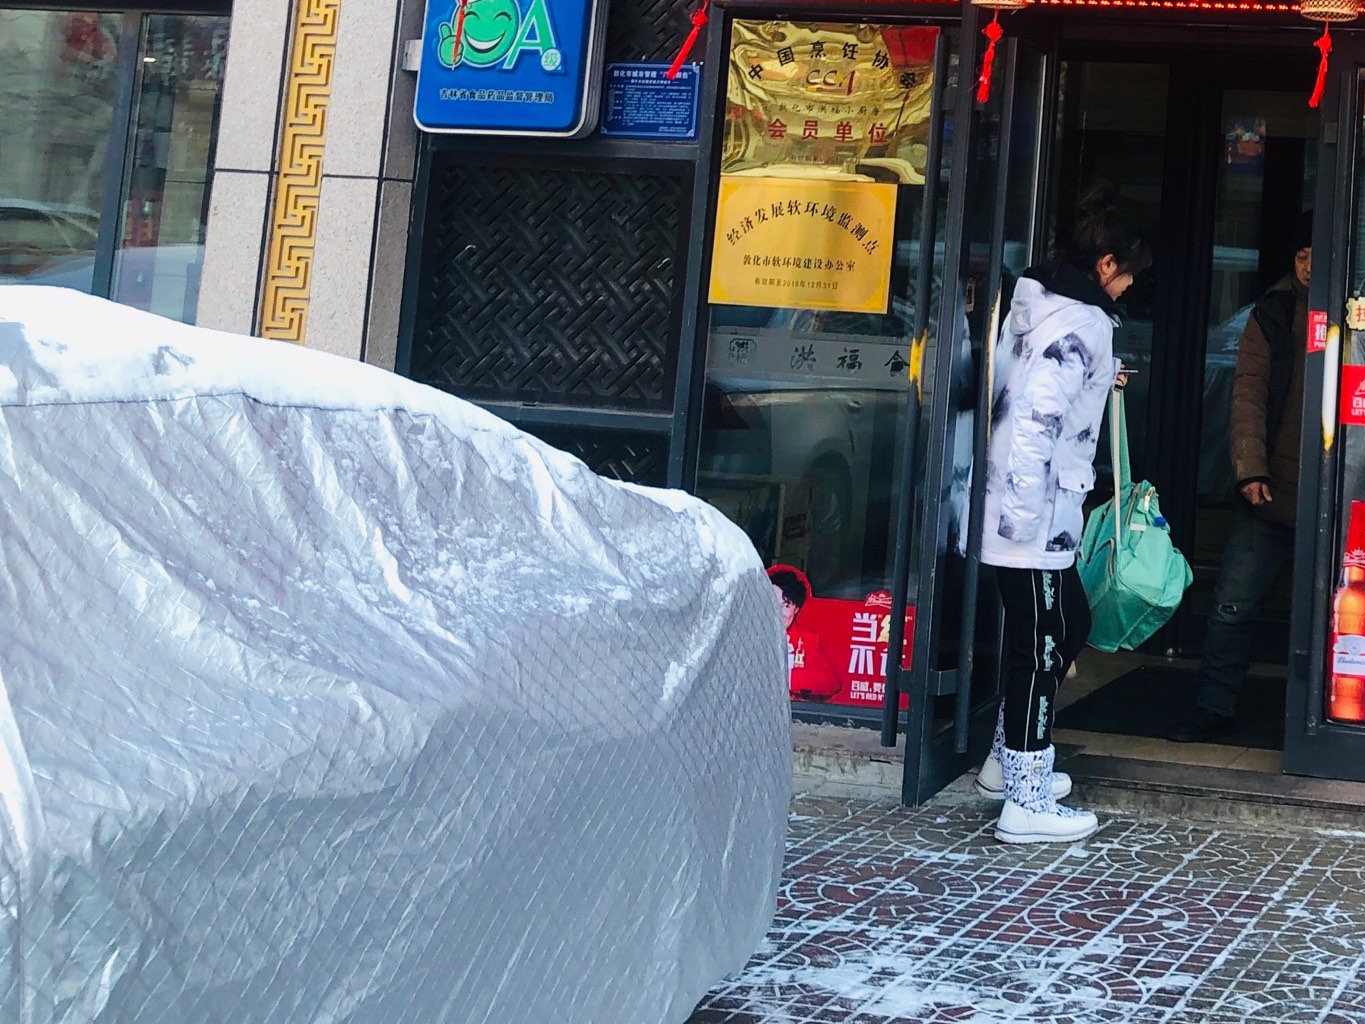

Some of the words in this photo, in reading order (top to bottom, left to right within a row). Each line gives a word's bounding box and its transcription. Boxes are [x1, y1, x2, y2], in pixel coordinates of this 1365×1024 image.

[748, 40, 919, 91] 中国烹饪协会
[439, 87, 555, 105] 吉林省食品药品监督管理局
[767, 118, 890, 144] 会员单位
[726, 199, 880, 255] 经济发展软环境监测点
[743, 254, 856, 272] 敦化市软环境建设办公室
[850, 691, 866, 700] LET'S
[866, 692, 878, 701] RED
